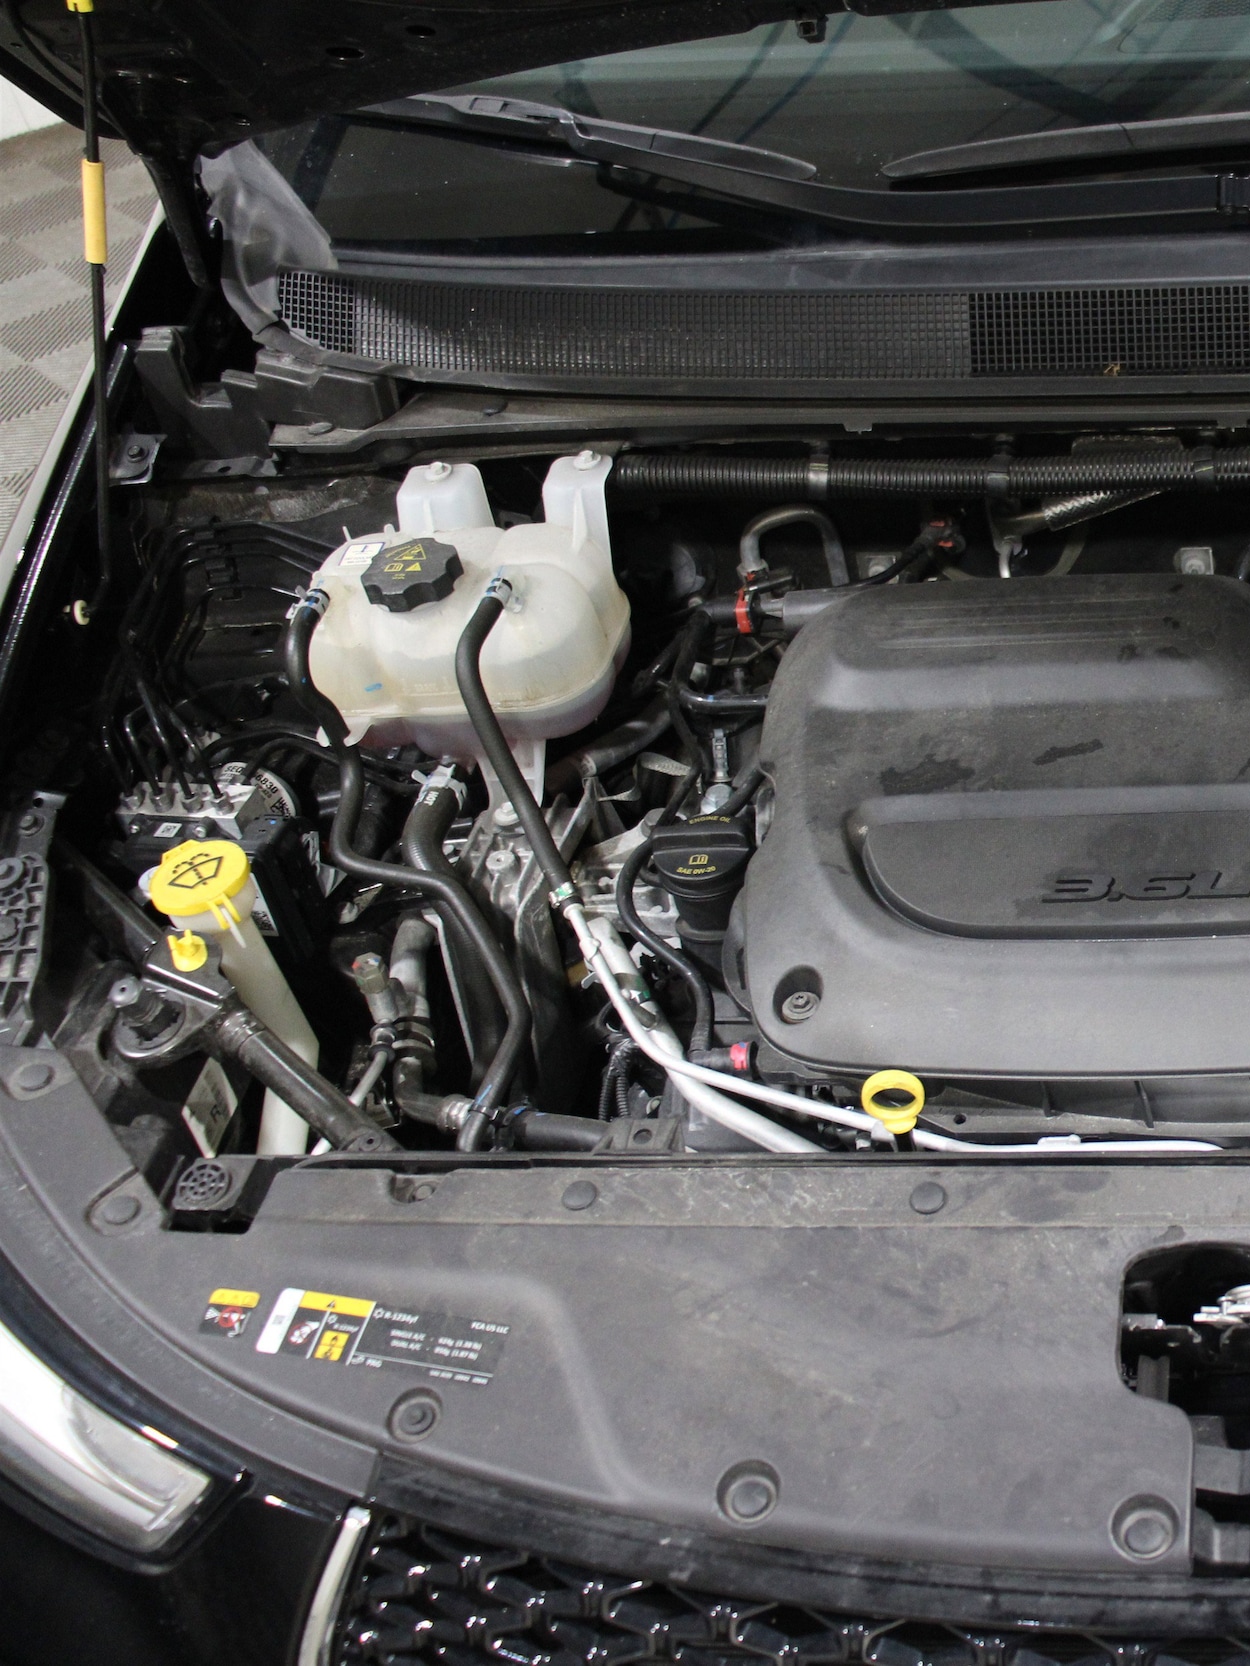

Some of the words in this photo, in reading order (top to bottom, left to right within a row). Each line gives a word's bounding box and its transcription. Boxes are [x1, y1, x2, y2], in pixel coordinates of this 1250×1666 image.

[688, 815, 719, 824] ENGINE
[676, 866, 692, 874] SAE
[384, 1311, 419, 1324] R-1234yf
[471, 1321, 485, 1331] FCA
[486, 1324, 496, 1332] US
[496, 1326, 510, 1334] LLC
